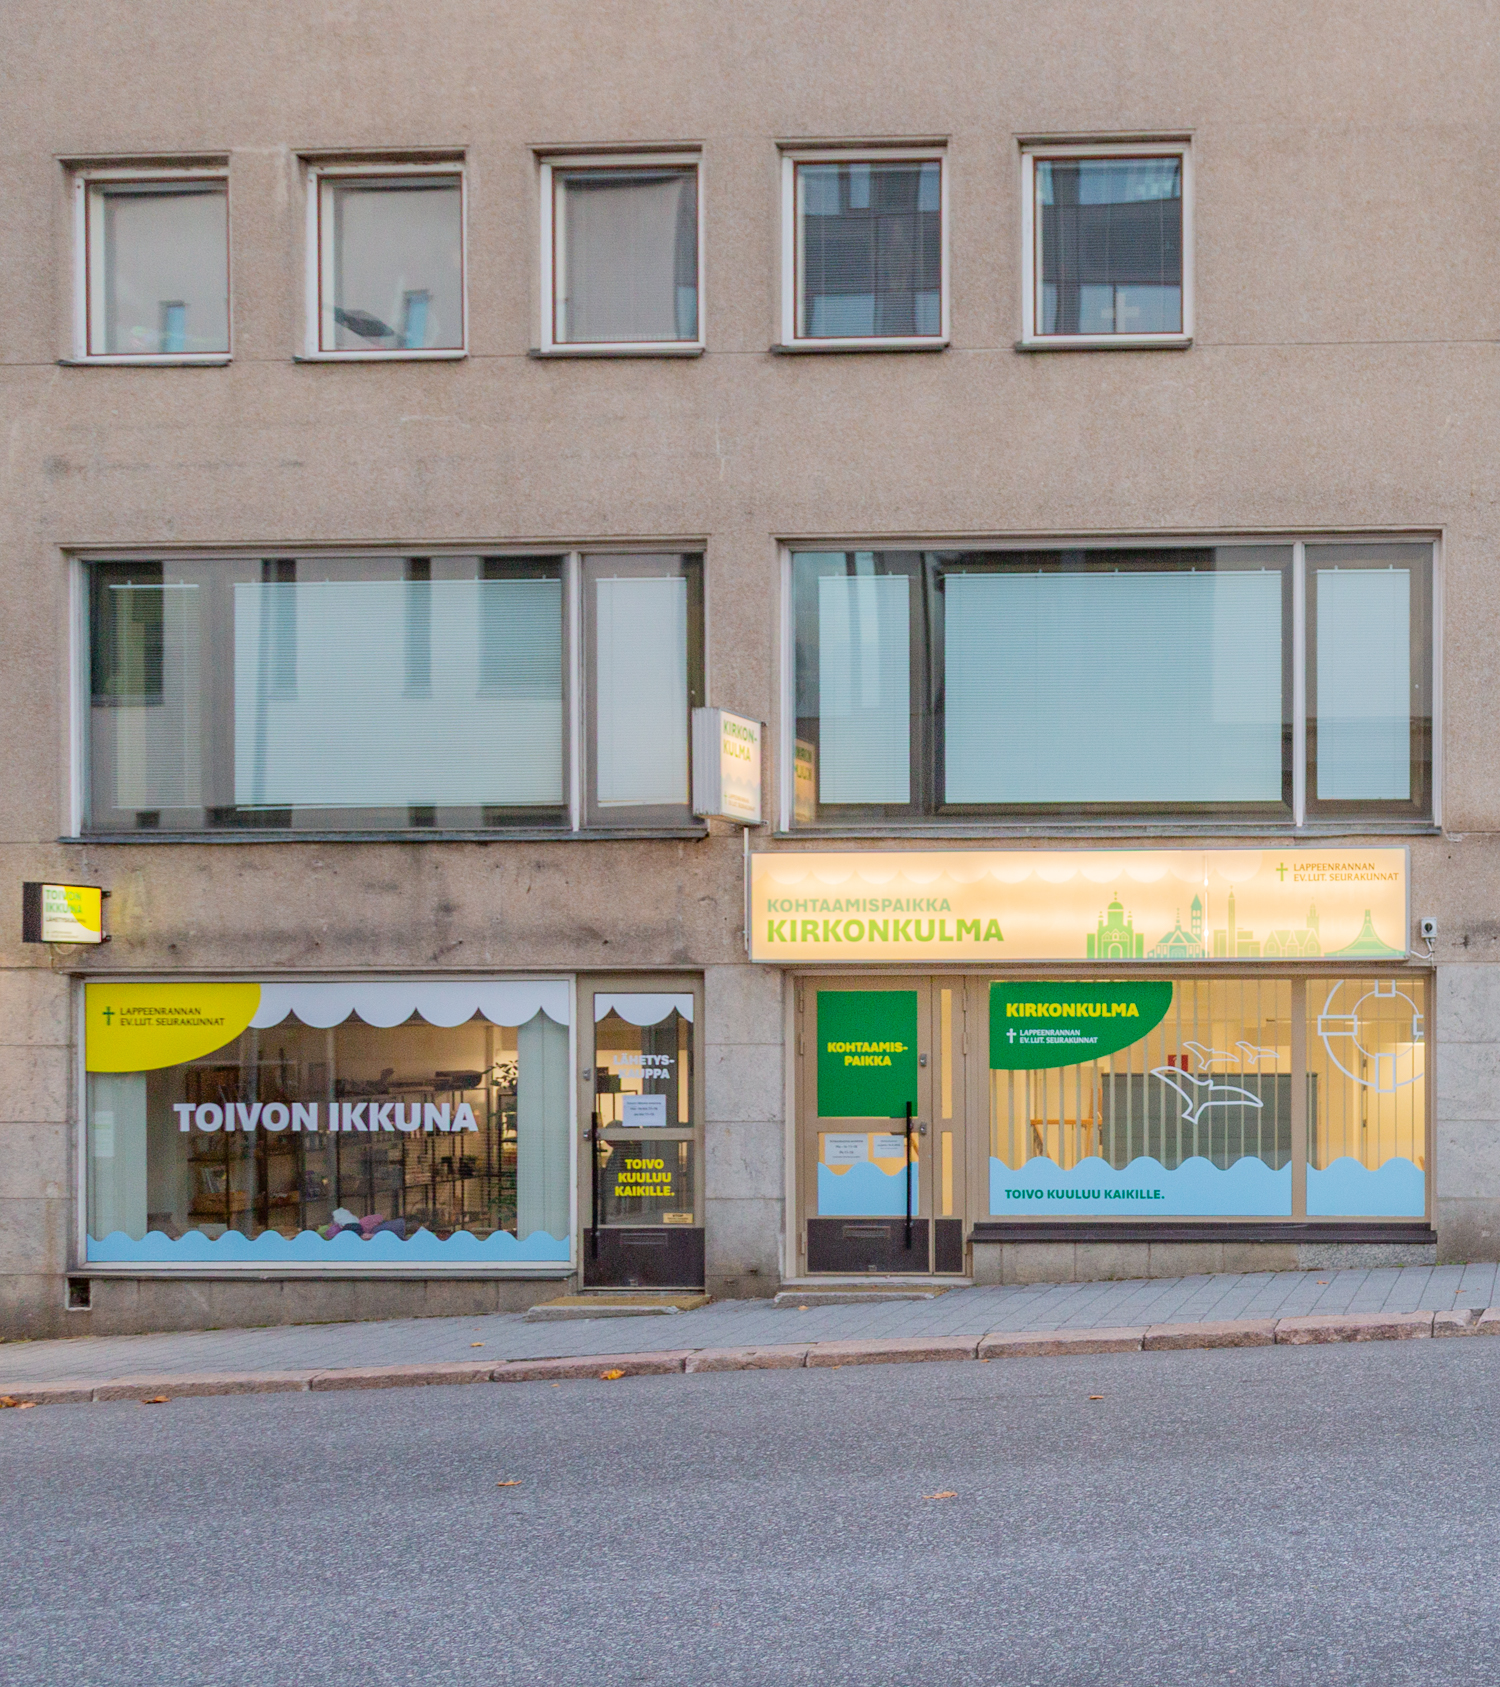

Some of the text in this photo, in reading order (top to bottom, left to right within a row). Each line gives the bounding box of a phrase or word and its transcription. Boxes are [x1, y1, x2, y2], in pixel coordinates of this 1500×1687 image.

[722, 719, 758, 744] KIRKON-
[722, 739, 752, 762] KULMA
[1293, 863, 1375, 872] LAPPEENRANNAN
[1293, 872, 1399, 882] EV.LUT. SEURAKUNNAT
[45, 889, 82, 901] TOIVON
[45, 902, 83, 914] IKKUNA
[767, 898, 952, 913] KOHTAAMISPAIKKA
[767, 918, 1005, 943] KIRKONKULMA
[120, 1007, 201, 1016] LAPPEENRANNAN
[1006, 1003, 1139, 1017] KIRKONKULMA
[120, 1017, 225, 1026] EV.LUT. SEURAKUNNAT
[827, 1042, 909, 1053] KOHTAAMIS-
[613, 1053, 675, 1066] LÄHETYS-
[844, 1055, 892, 1066] PAIKKA
[618, 1068, 670, 1079] KAUPPA
[173, 1102, 479, 1132] TOIVON IKKUNA
[624, 1158, 664, 1170] TOIVO
[617, 1172, 672, 1183] KUULUU
[614, 1185, 675, 1197] KAIKILLE.
[1005, 1189, 1165, 1199] TOIVO KUULUU KAIKILLE.
